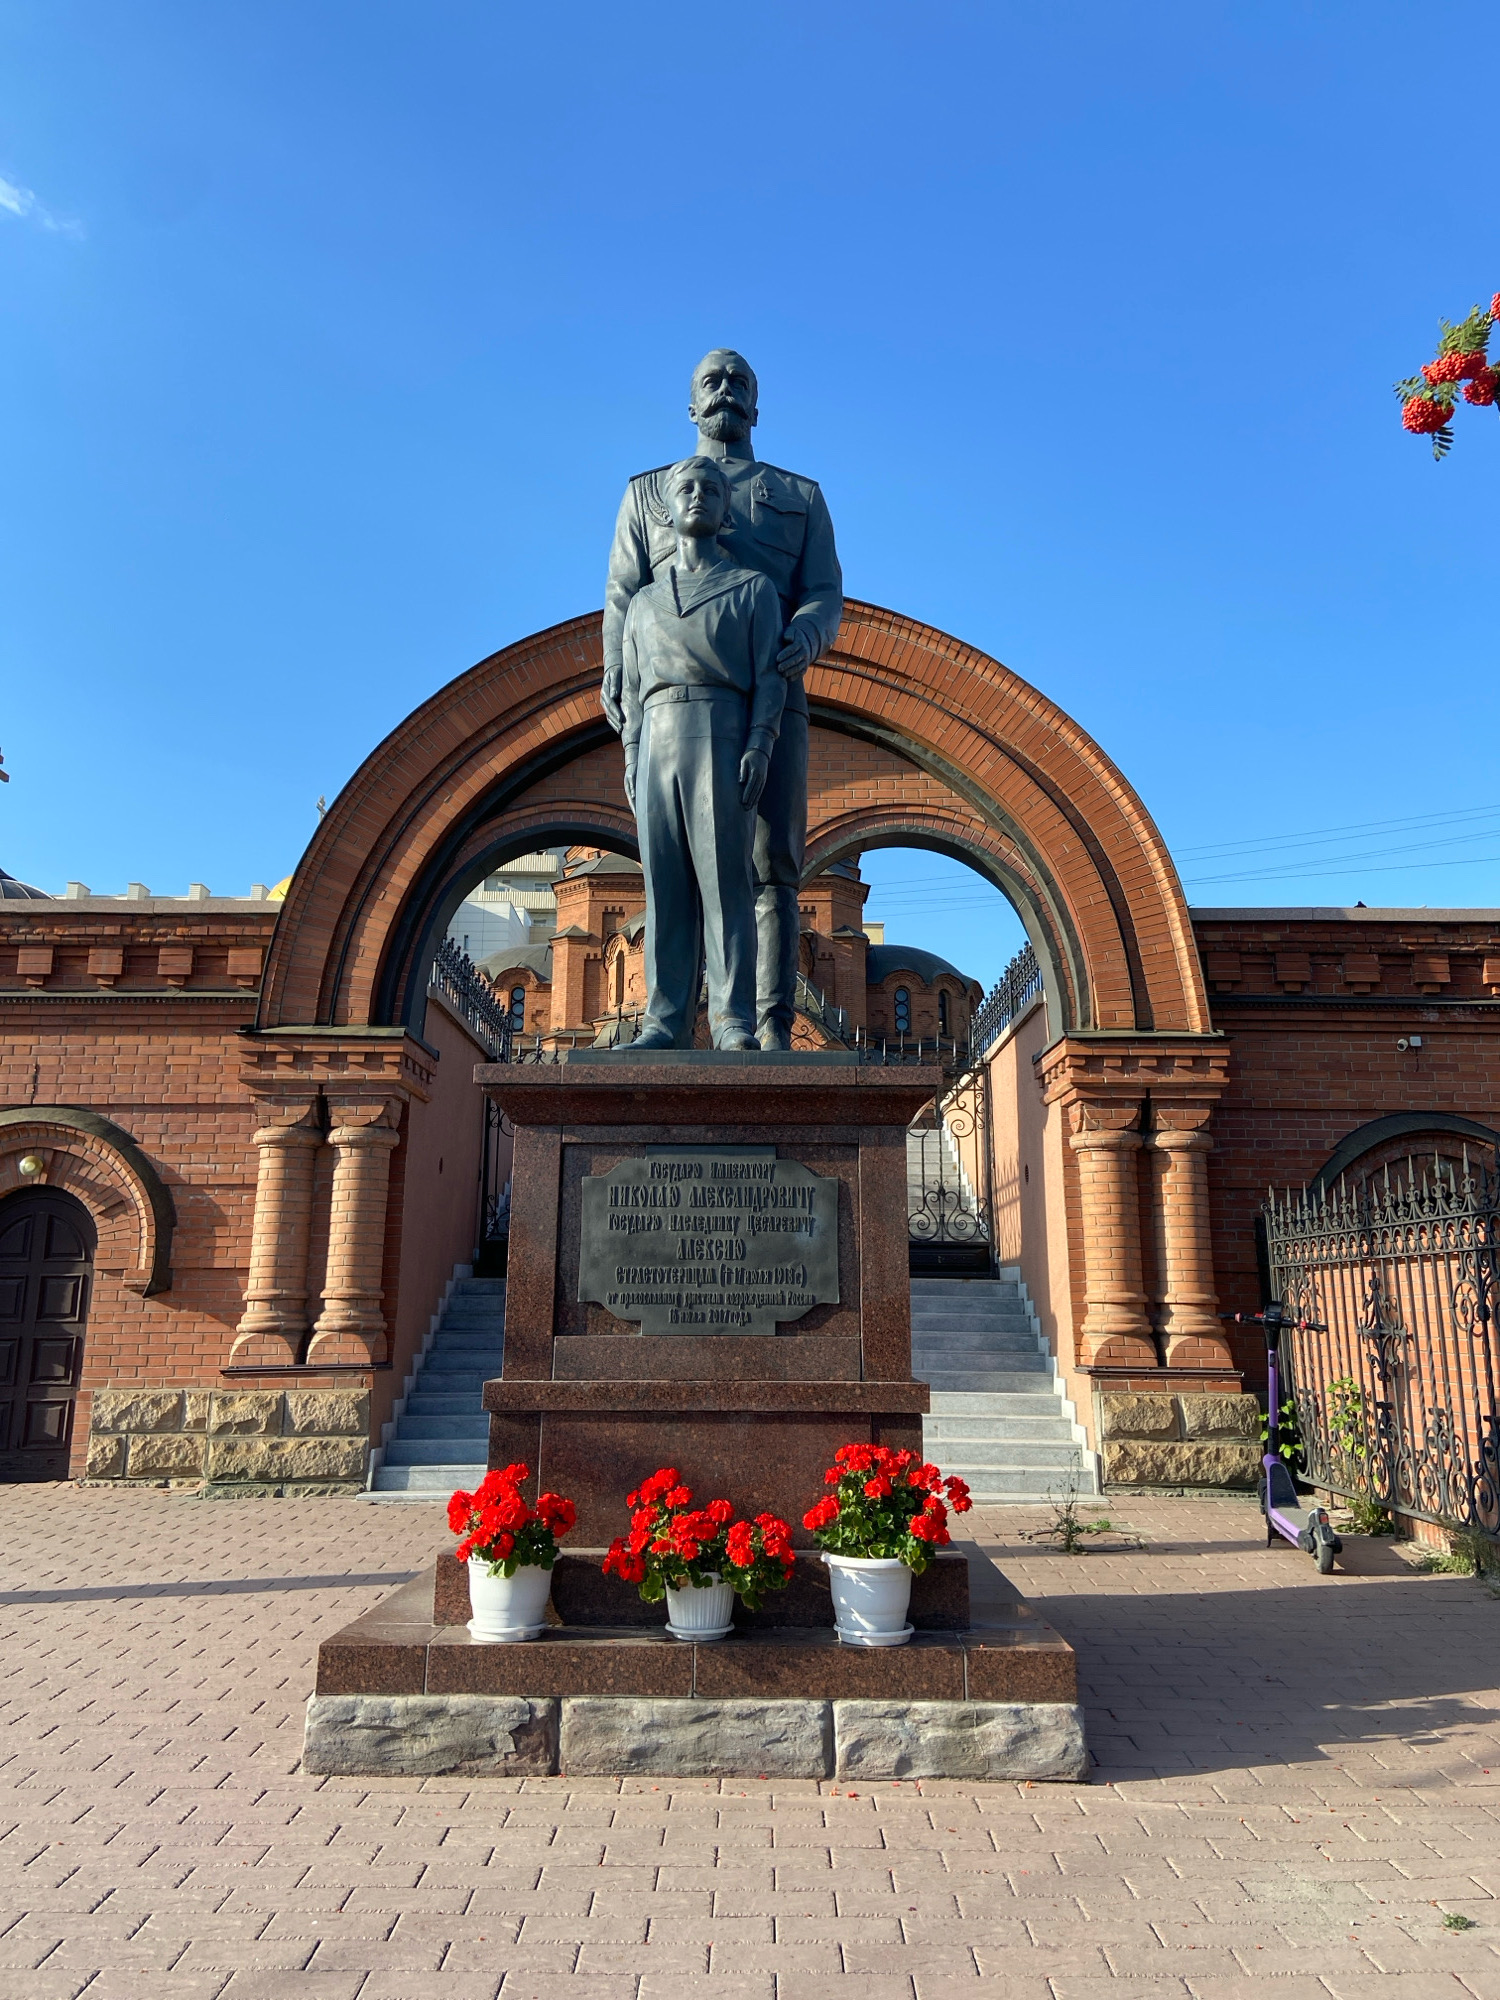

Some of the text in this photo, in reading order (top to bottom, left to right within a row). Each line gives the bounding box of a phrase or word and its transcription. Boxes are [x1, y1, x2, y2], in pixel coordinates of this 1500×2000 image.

[608, 1185, 816, 1215] НИКОЛАЮ АЛЕКСАНДРОВИЧУ
[677, 1238, 746, 1261] АЛЕКСИЮ
